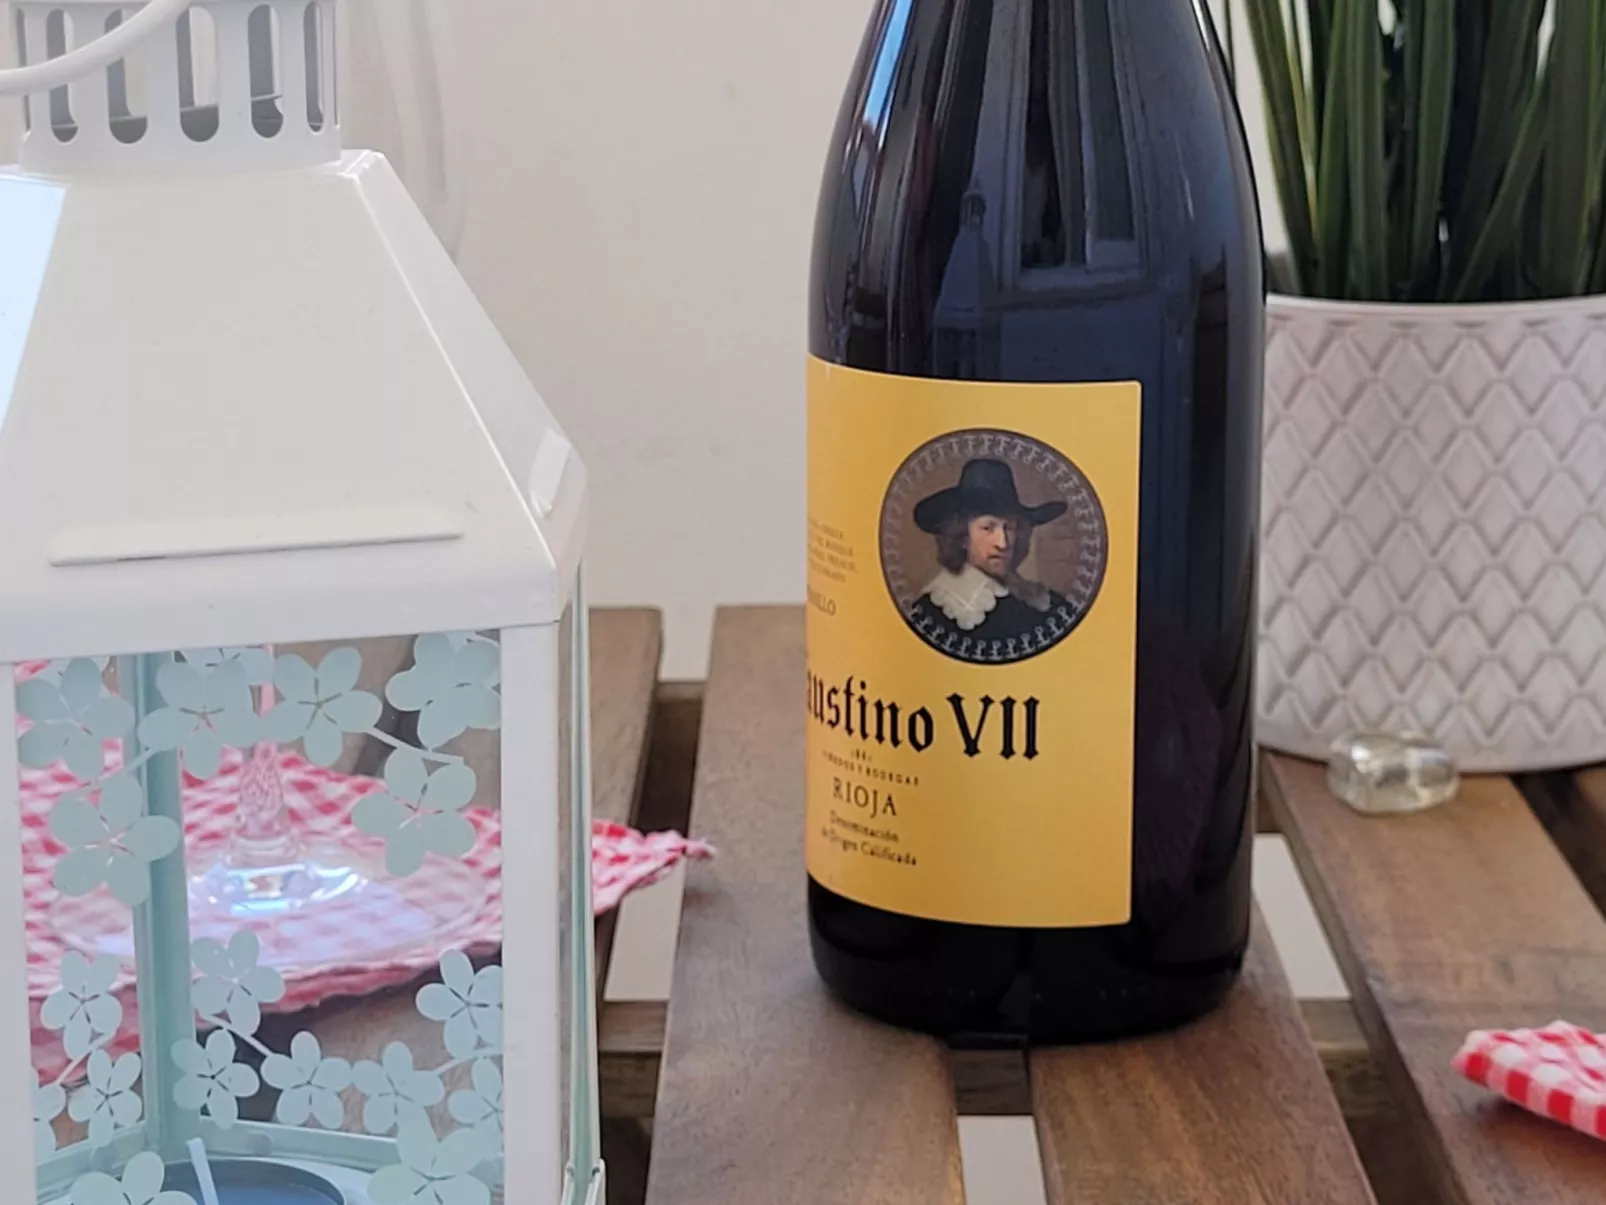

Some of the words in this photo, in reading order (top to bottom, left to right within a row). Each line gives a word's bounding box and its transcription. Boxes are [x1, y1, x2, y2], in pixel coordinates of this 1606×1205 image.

[945, 692, 1040, 760] VII
[832, 776, 897, 819] RIOJA
[860, 841, 917, 866] Calificada
